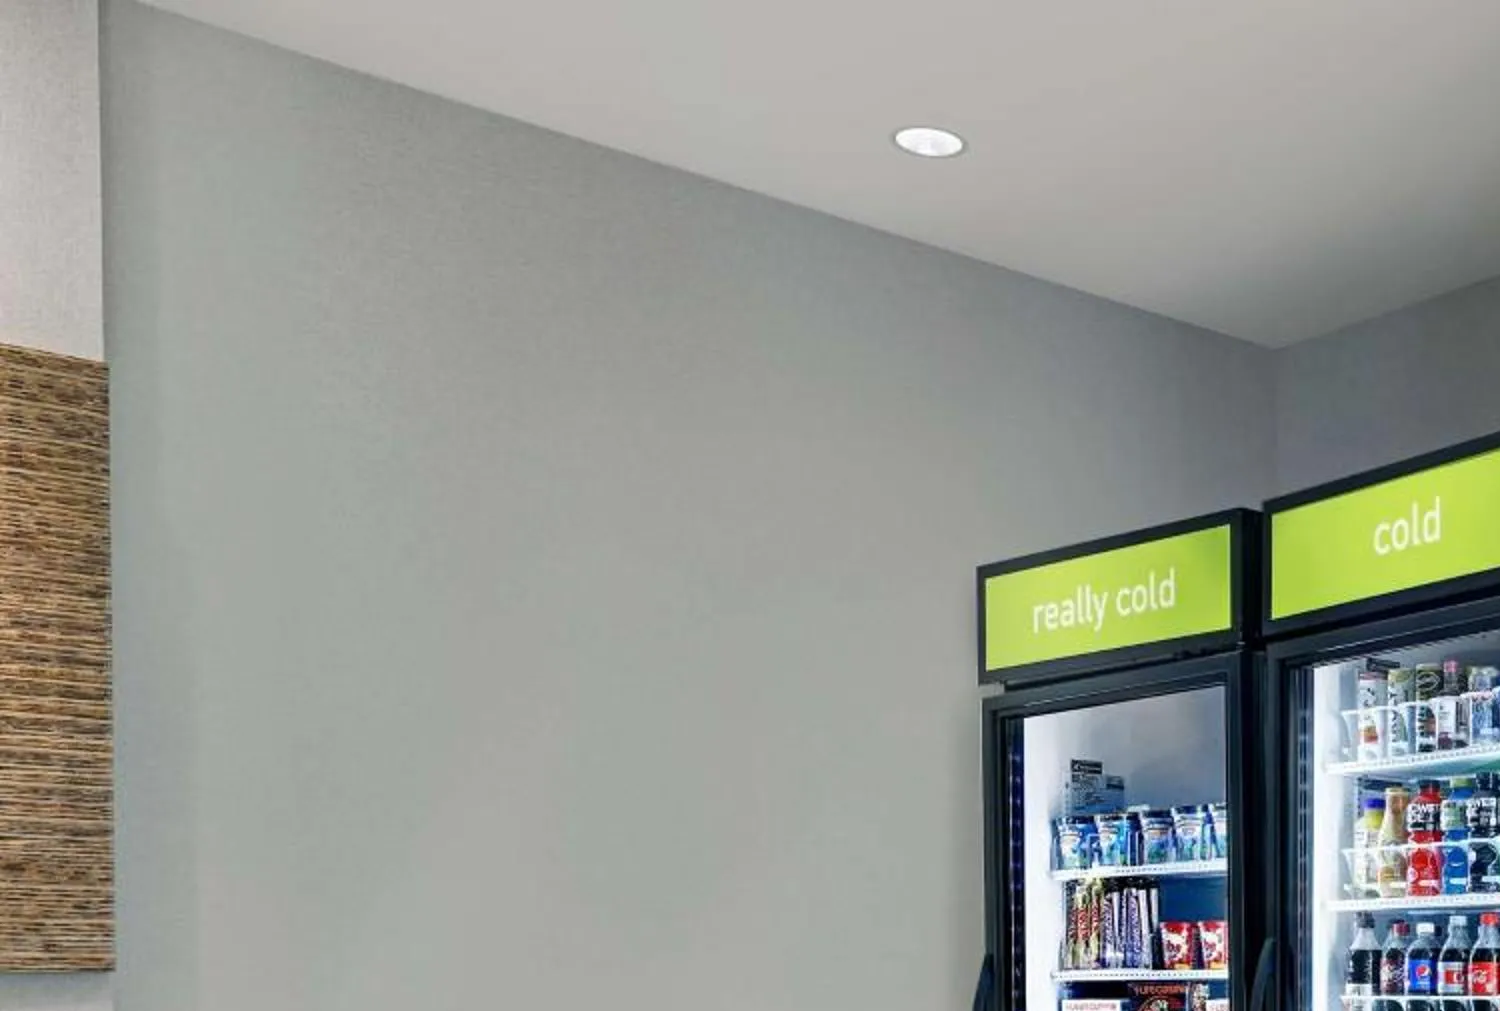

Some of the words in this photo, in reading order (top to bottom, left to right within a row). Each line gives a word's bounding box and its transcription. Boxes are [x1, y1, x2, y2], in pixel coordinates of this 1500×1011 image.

[1373, 496, 1442, 556] cold
[1032, 582, 1109, 634] really
[1115, 567, 1176, 618] cold
